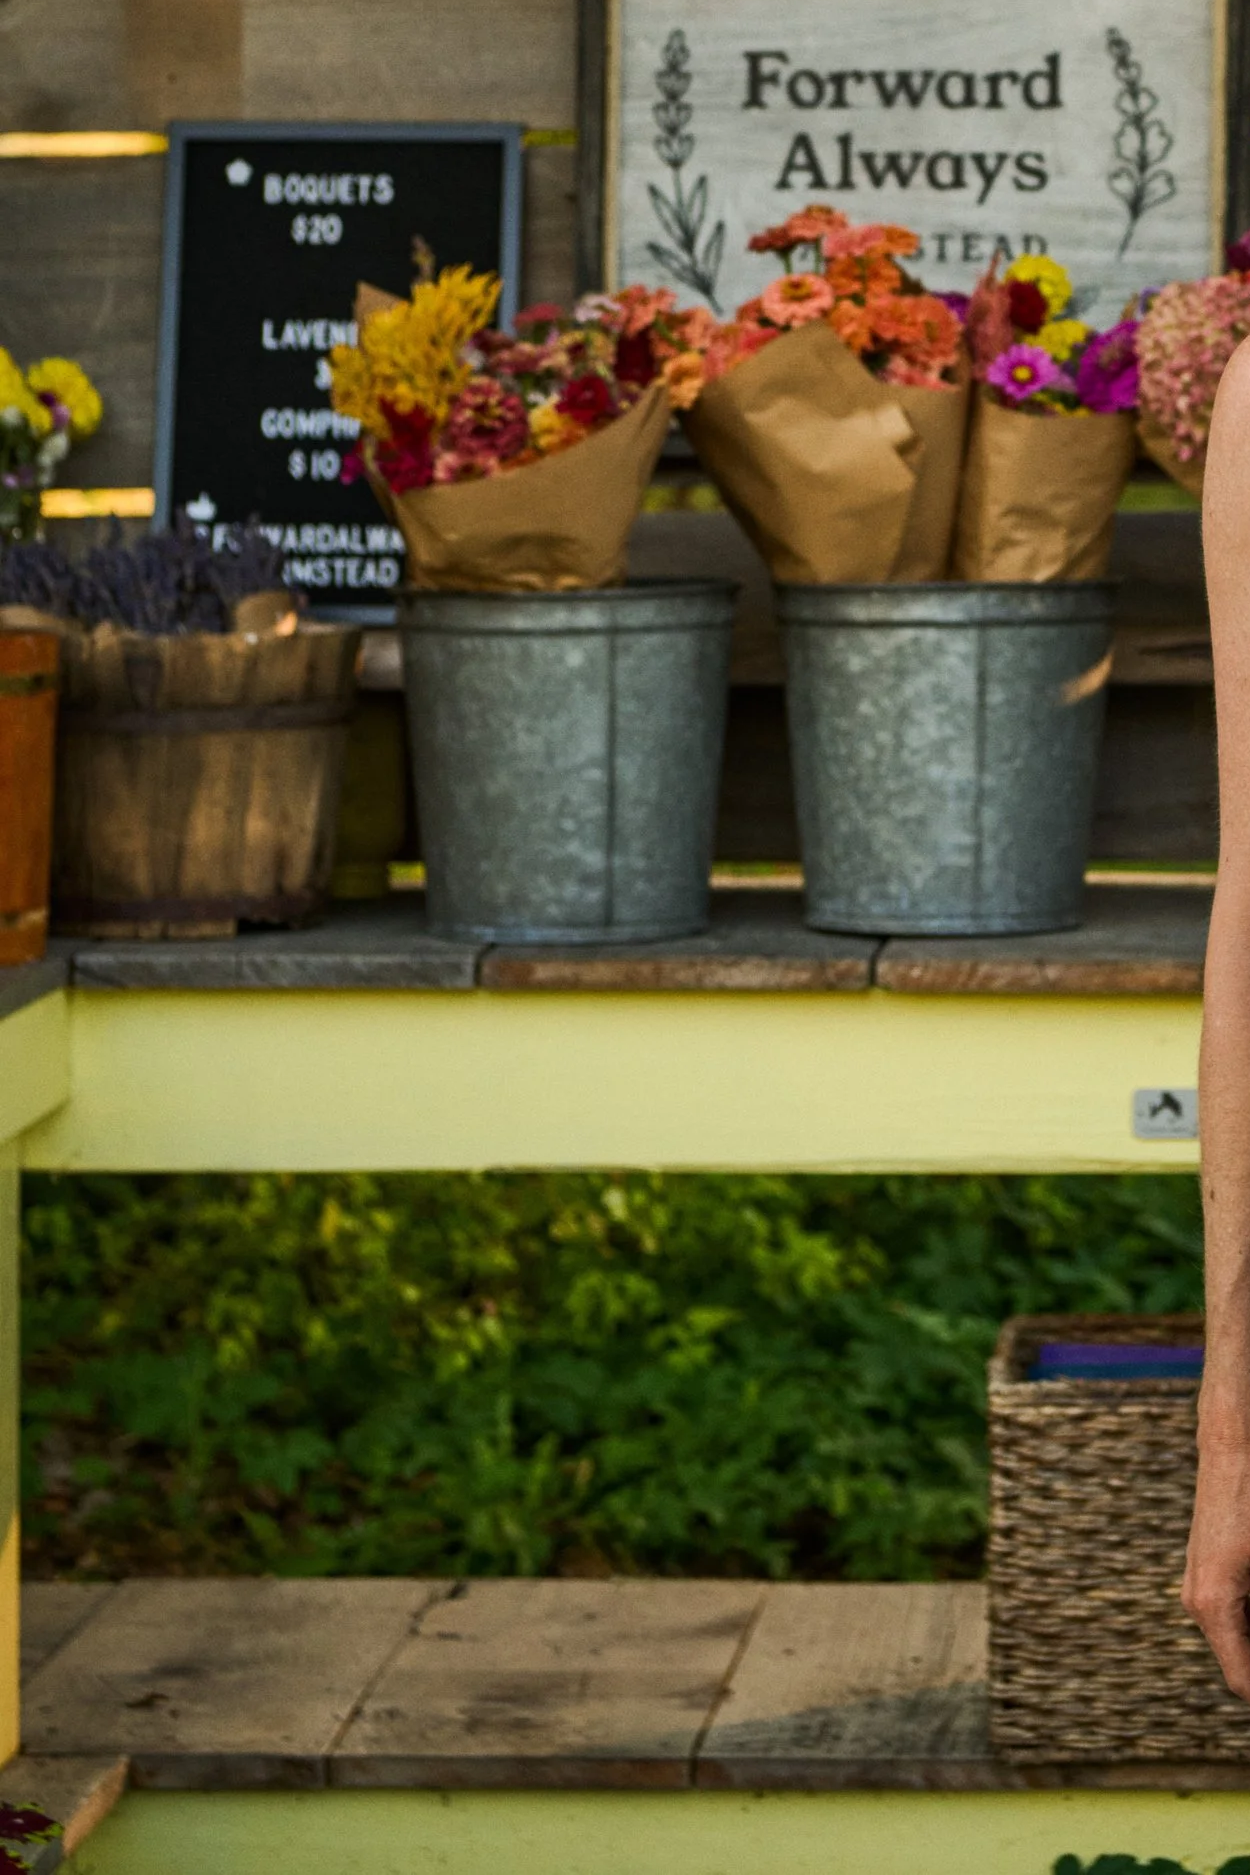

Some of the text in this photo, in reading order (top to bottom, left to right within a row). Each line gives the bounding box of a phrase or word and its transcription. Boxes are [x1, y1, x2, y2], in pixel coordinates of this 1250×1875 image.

[741, 50, 1064, 111] Forward
[774, 131, 1049, 205] Always
[264, 174, 395, 205] BOQUETS
[292, 214, 344, 245] $20
[288, 449, 341, 481] $10
